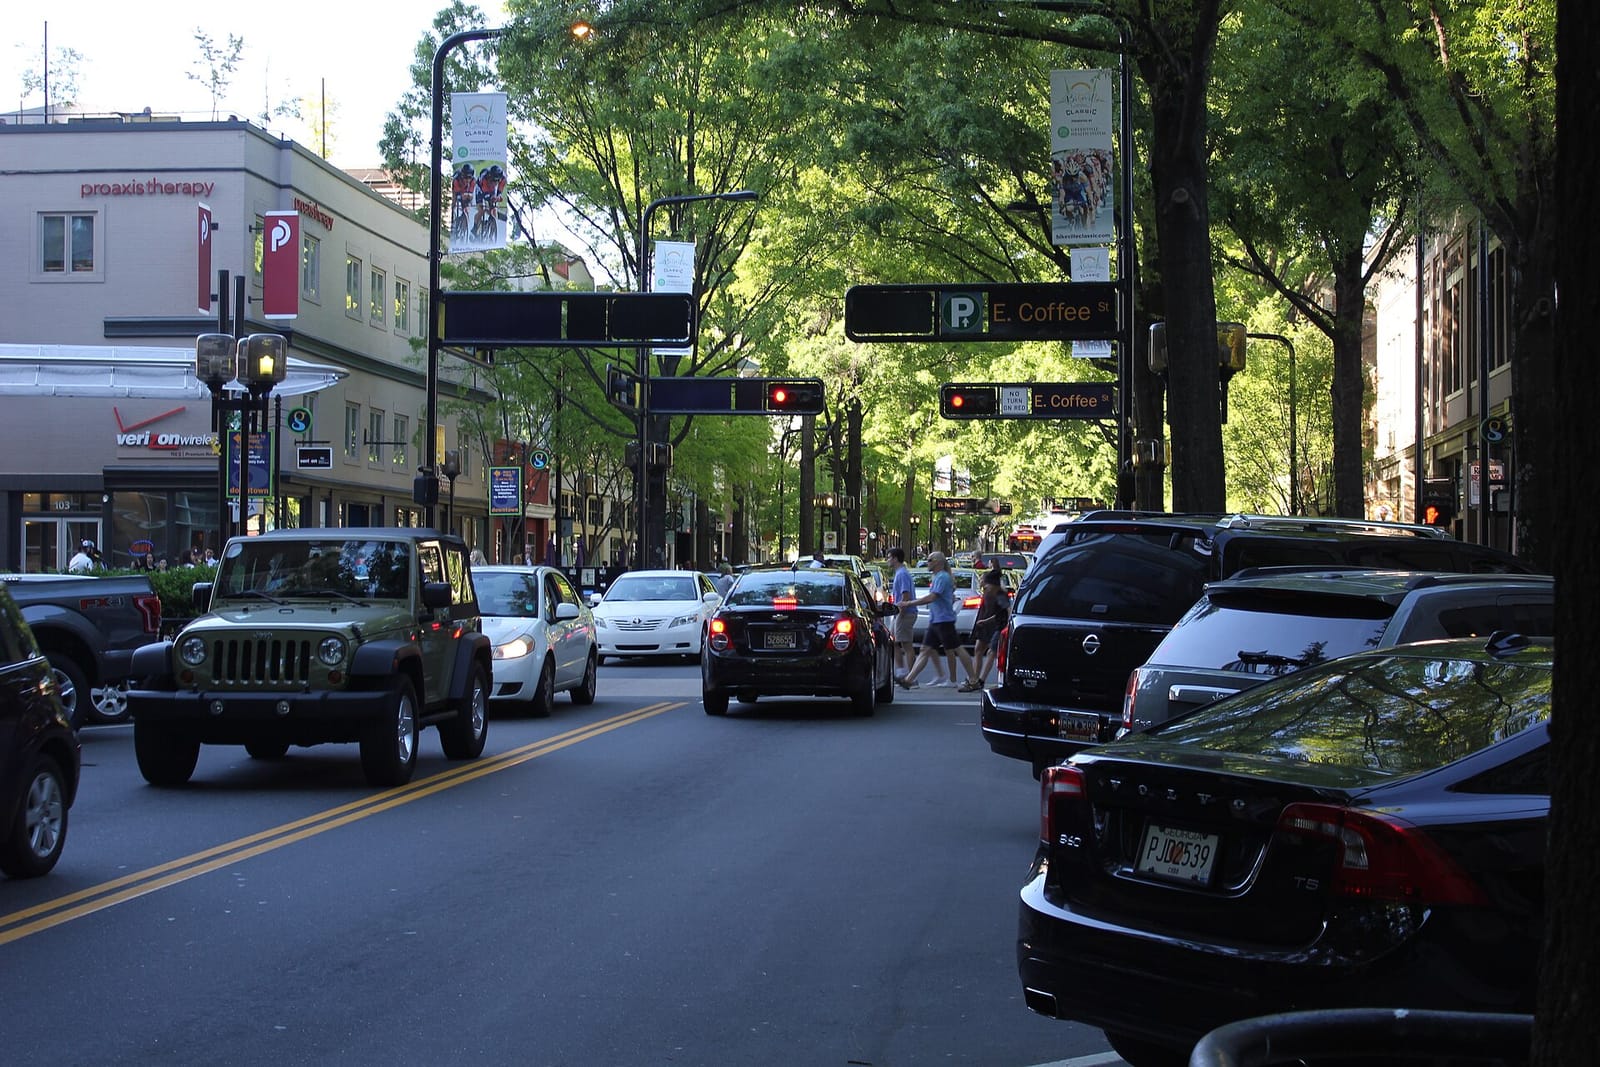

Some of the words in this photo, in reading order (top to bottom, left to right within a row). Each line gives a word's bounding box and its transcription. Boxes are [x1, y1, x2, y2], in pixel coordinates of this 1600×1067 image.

[951, 297, 975, 328] P
[993, 303, 1010, 321] E.
[1019, 302, 1091, 321] Coffee
[1097, 301, 1109, 312] St
[1034, 395, 1047, 408] E.
[1050, 394, 1097, 408] Coffee
[229, 486, 269, 495] dotown
[55, 501, 70, 510] 103
[1059, 833, 1081, 848] S60
[1163, 826, 1203, 841] GEORGIA
[1147, 836, 1211, 869] PJD2539
[1293, 876, 1320, 890] T5
